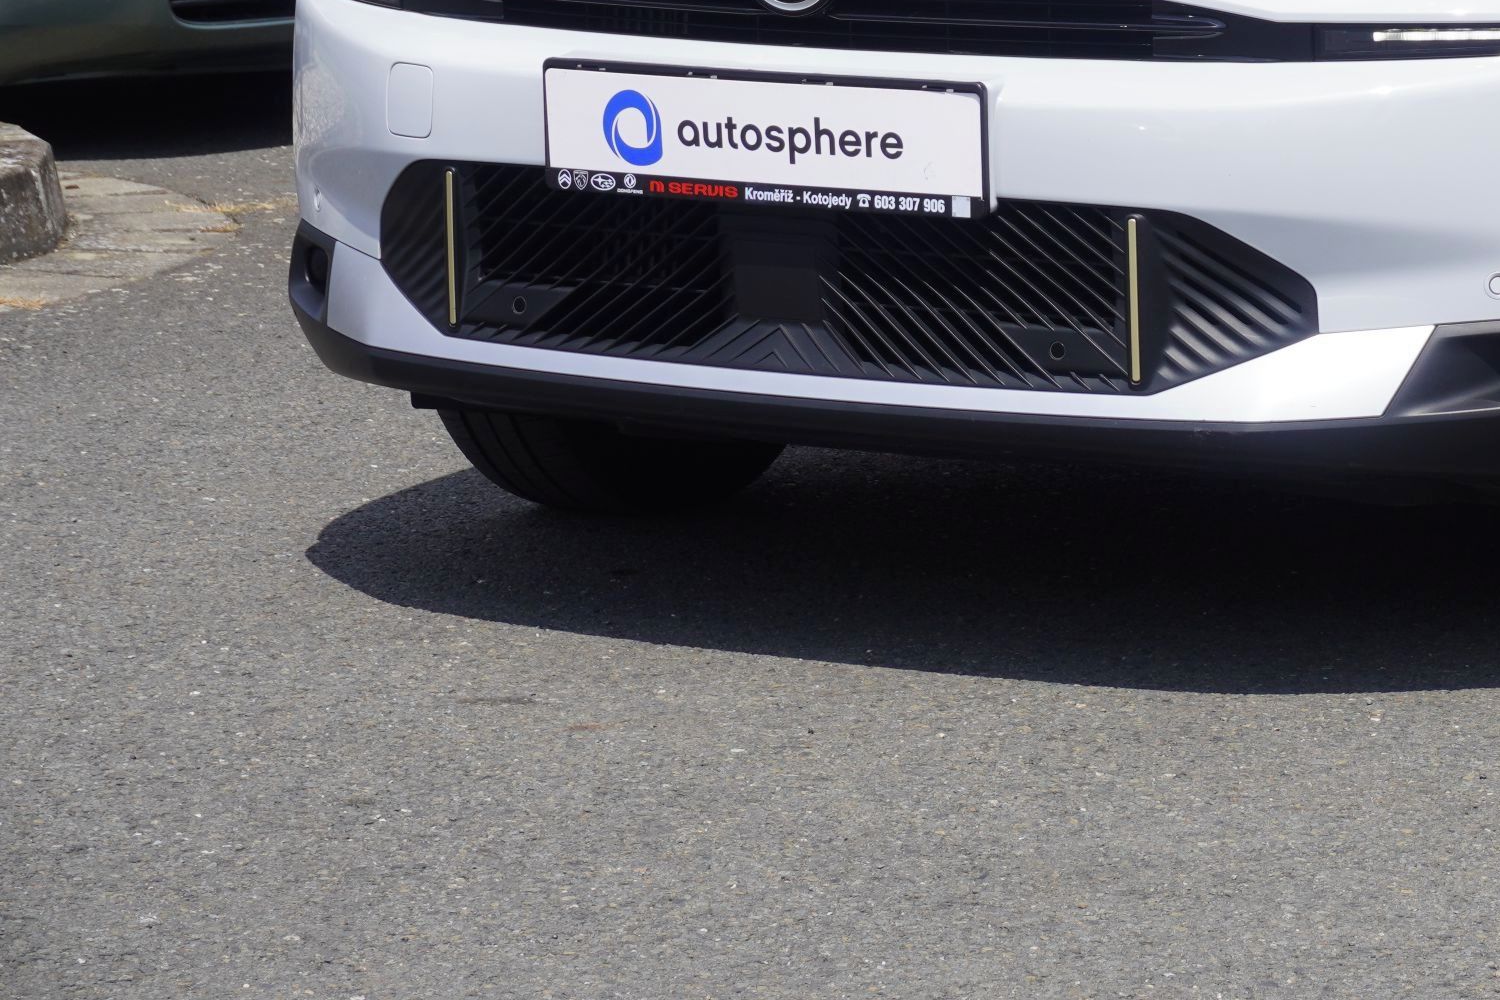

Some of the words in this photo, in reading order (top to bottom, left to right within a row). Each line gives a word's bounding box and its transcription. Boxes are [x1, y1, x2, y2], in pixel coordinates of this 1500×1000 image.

[677, 116, 904, 164] autosphere
[668, 182, 738, 198] SERVIS
[745, 187, 794, 203] Kroměříž
[803, 191, 852, 209] Kotojedy
[874, 195, 896, 209] 603
[899, 197, 920, 211] 307
[923, 199, 945, 213] 906
